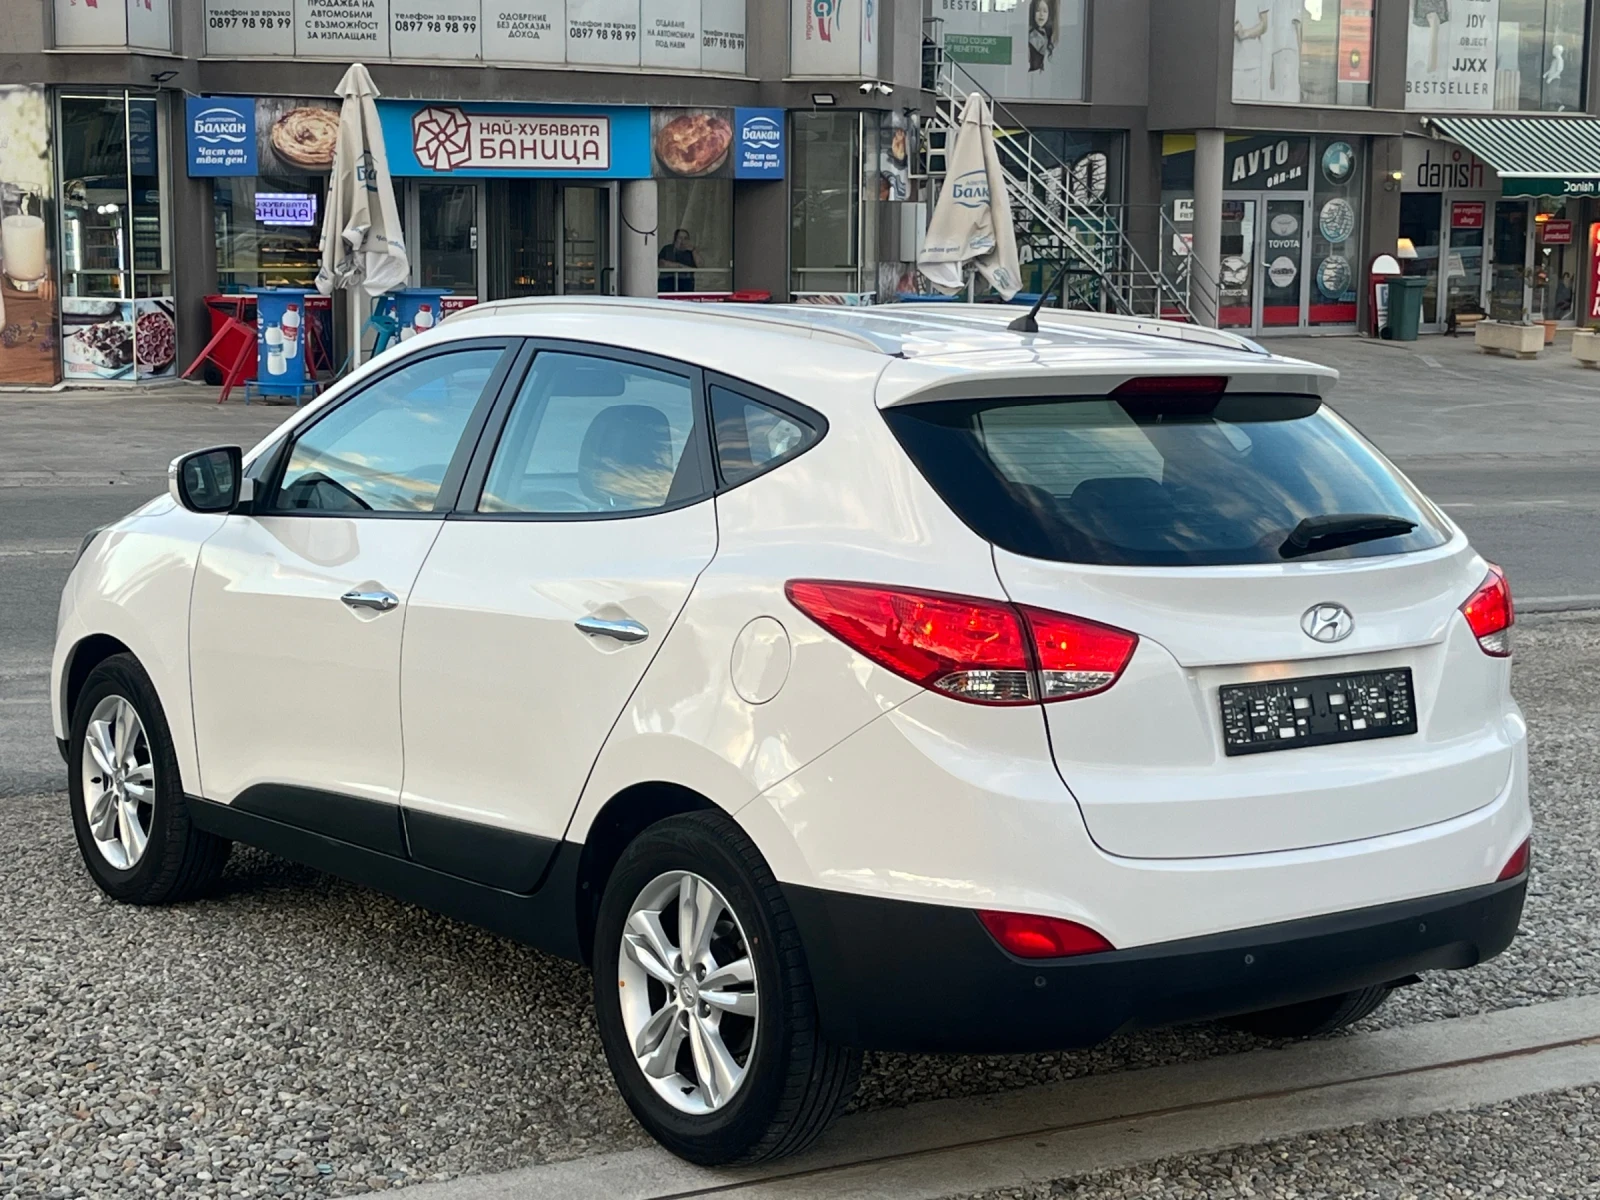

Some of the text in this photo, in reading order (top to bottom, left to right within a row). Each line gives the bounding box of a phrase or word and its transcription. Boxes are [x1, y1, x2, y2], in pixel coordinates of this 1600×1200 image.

[209, 9, 248, 17] телефон
[310, 9, 372, 18] АВТОМОБИЛИ
[499, 12, 546, 22] ОДОБРЕНИЕ
[209, 17, 291, 29] 0897 98 98 99
[305, 20, 379, 30] С ВЪЗМОЖНОСТ
[395, 20, 477, 34] 0897 98 98 99
[512, 21, 551, 31] ДОКАЗАН
[570, 20, 602, 28] телефон
[1466, 14, 1486, 28] JDY
[307, 31, 377, 41] ЗА ИЗПЛАЩАНЕ
[507, 29, 541, 39] ДОХОД
[570, 27, 637, 42] 0897 98 98 99
[703, 36, 744, 50] 0897 98 98 99
[1452, 57, 1488, 72] JJXX
[1405, 80, 1489, 95] BESTSELLER
[194, 119, 247, 134] Балкан
[479, 119, 600, 137] НАЙ-ХУБАВАТА
[742, 127, 780, 141] Балкан
[198, 146, 244, 156] Част от
[480, 138, 599, 165] БАНИЦА
[195, 155, 248, 167] твоя ден!
[1231, 140, 1289, 183] АУТО
[1417, 149, 1483, 188] danish
[1563, 181, 1595, 192] Danish
[1268, 239, 1300, 249] TOYOTA
